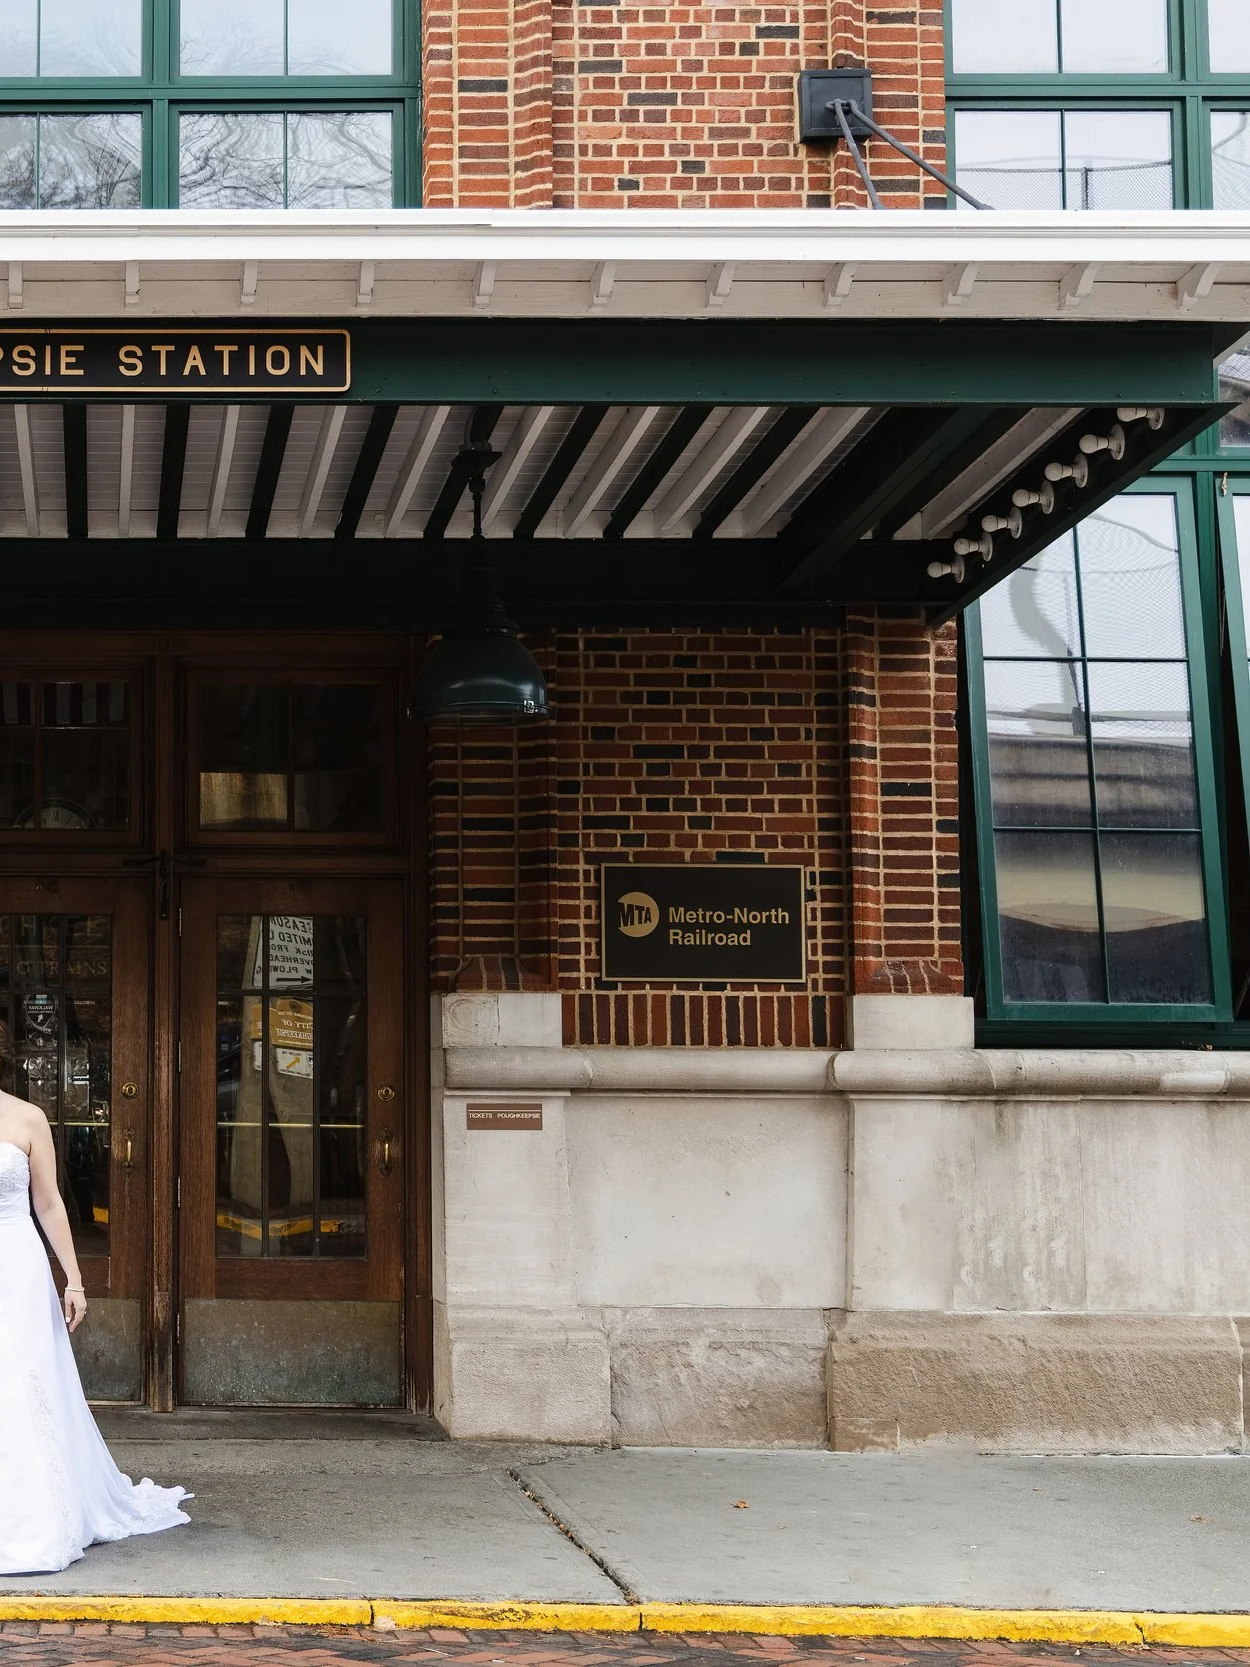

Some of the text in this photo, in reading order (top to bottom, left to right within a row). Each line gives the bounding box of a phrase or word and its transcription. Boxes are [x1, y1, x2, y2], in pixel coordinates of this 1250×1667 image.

[118, 344, 326, 377] STATION
[618, 901, 652, 928] MTA
[668, 906, 790, 925] Metro-North
[668, 929, 751, 946] Railroad
